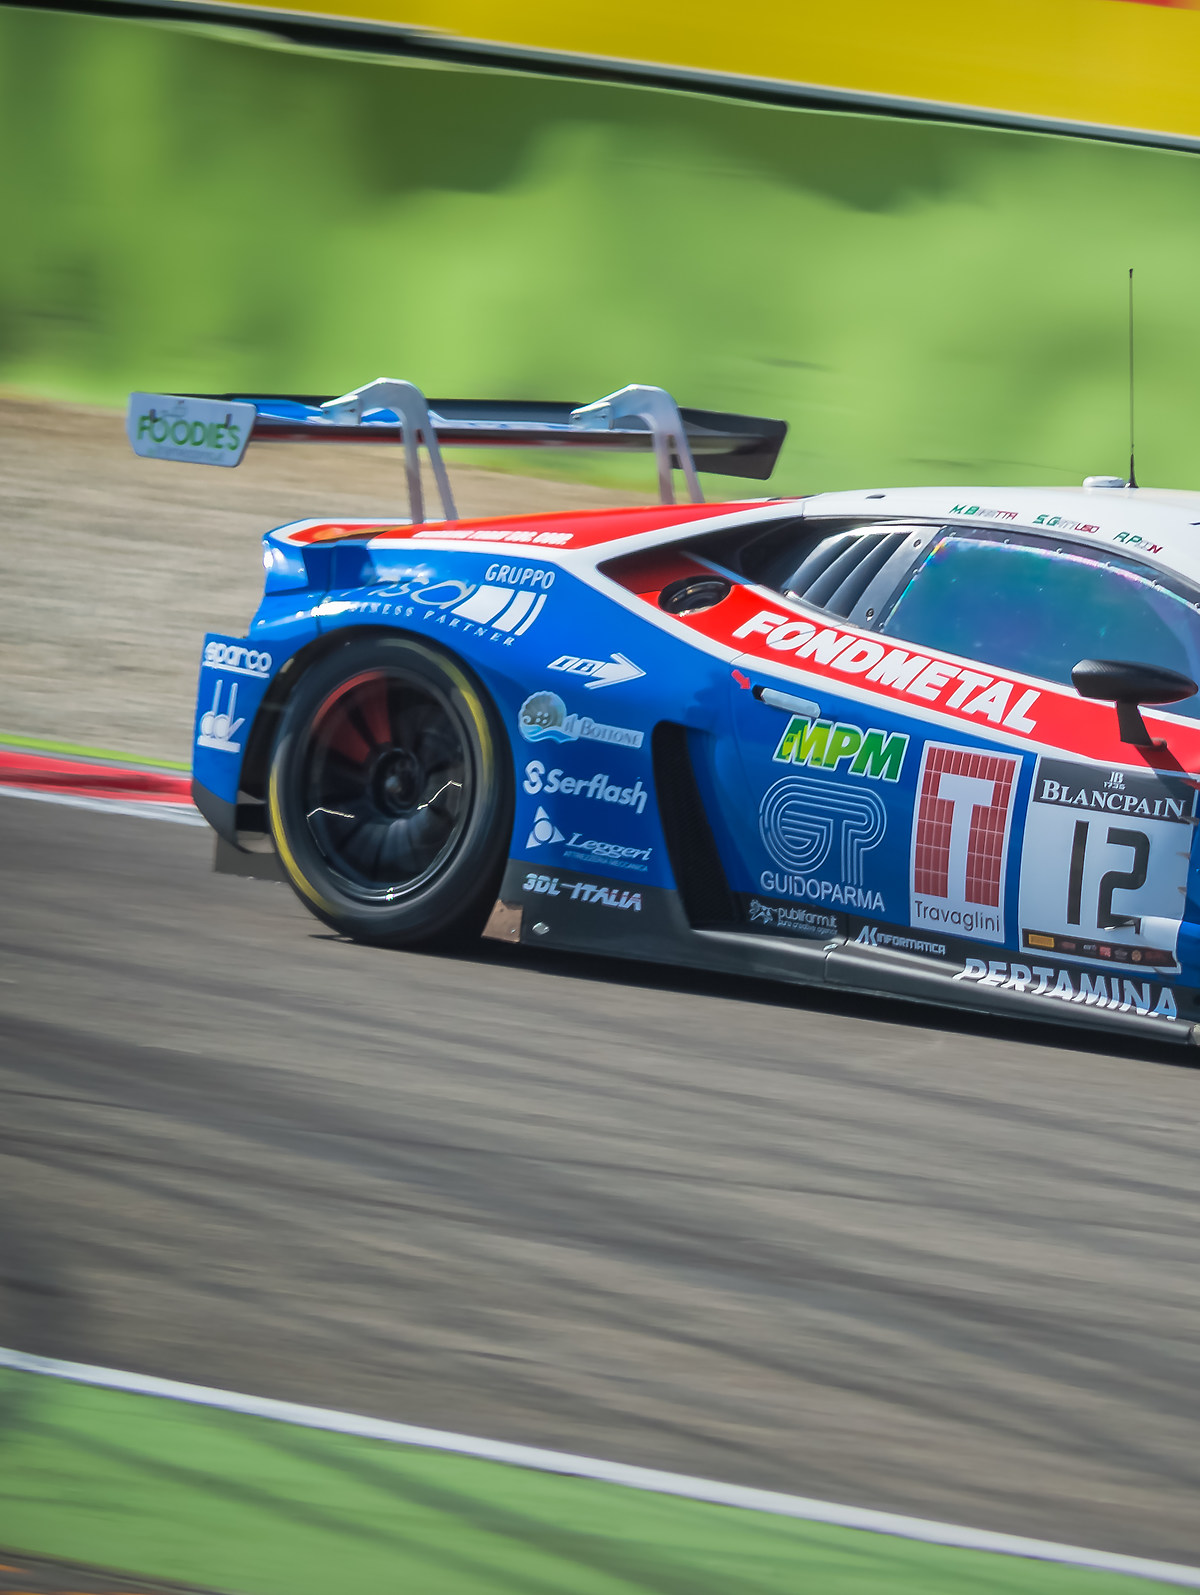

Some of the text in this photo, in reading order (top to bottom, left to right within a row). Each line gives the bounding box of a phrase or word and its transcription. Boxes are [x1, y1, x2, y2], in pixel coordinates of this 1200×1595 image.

[137, 414, 241, 451] FOODIES
[484, 563, 556, 591] GRUPPO
[422, 610, 517, 647] PARTNER
[204, 641, 273, 673] sparco
[732, 610, 1042, 735] FONDMETAL
[772, 714, 911, 784] MPM
[543, 768, 648, 814] Serflash
[1041, 778, 1186, 820] BLANCPAIN
[565, 832, 653, 861] Leggeri
[760, 870, 886, 912] GUIDOPARMA
[1067, 819, 1150, 935] 12
[914, 900, 1001, 932] Travaglini
[952, 957, 1178, 1021] PERTAMINA
